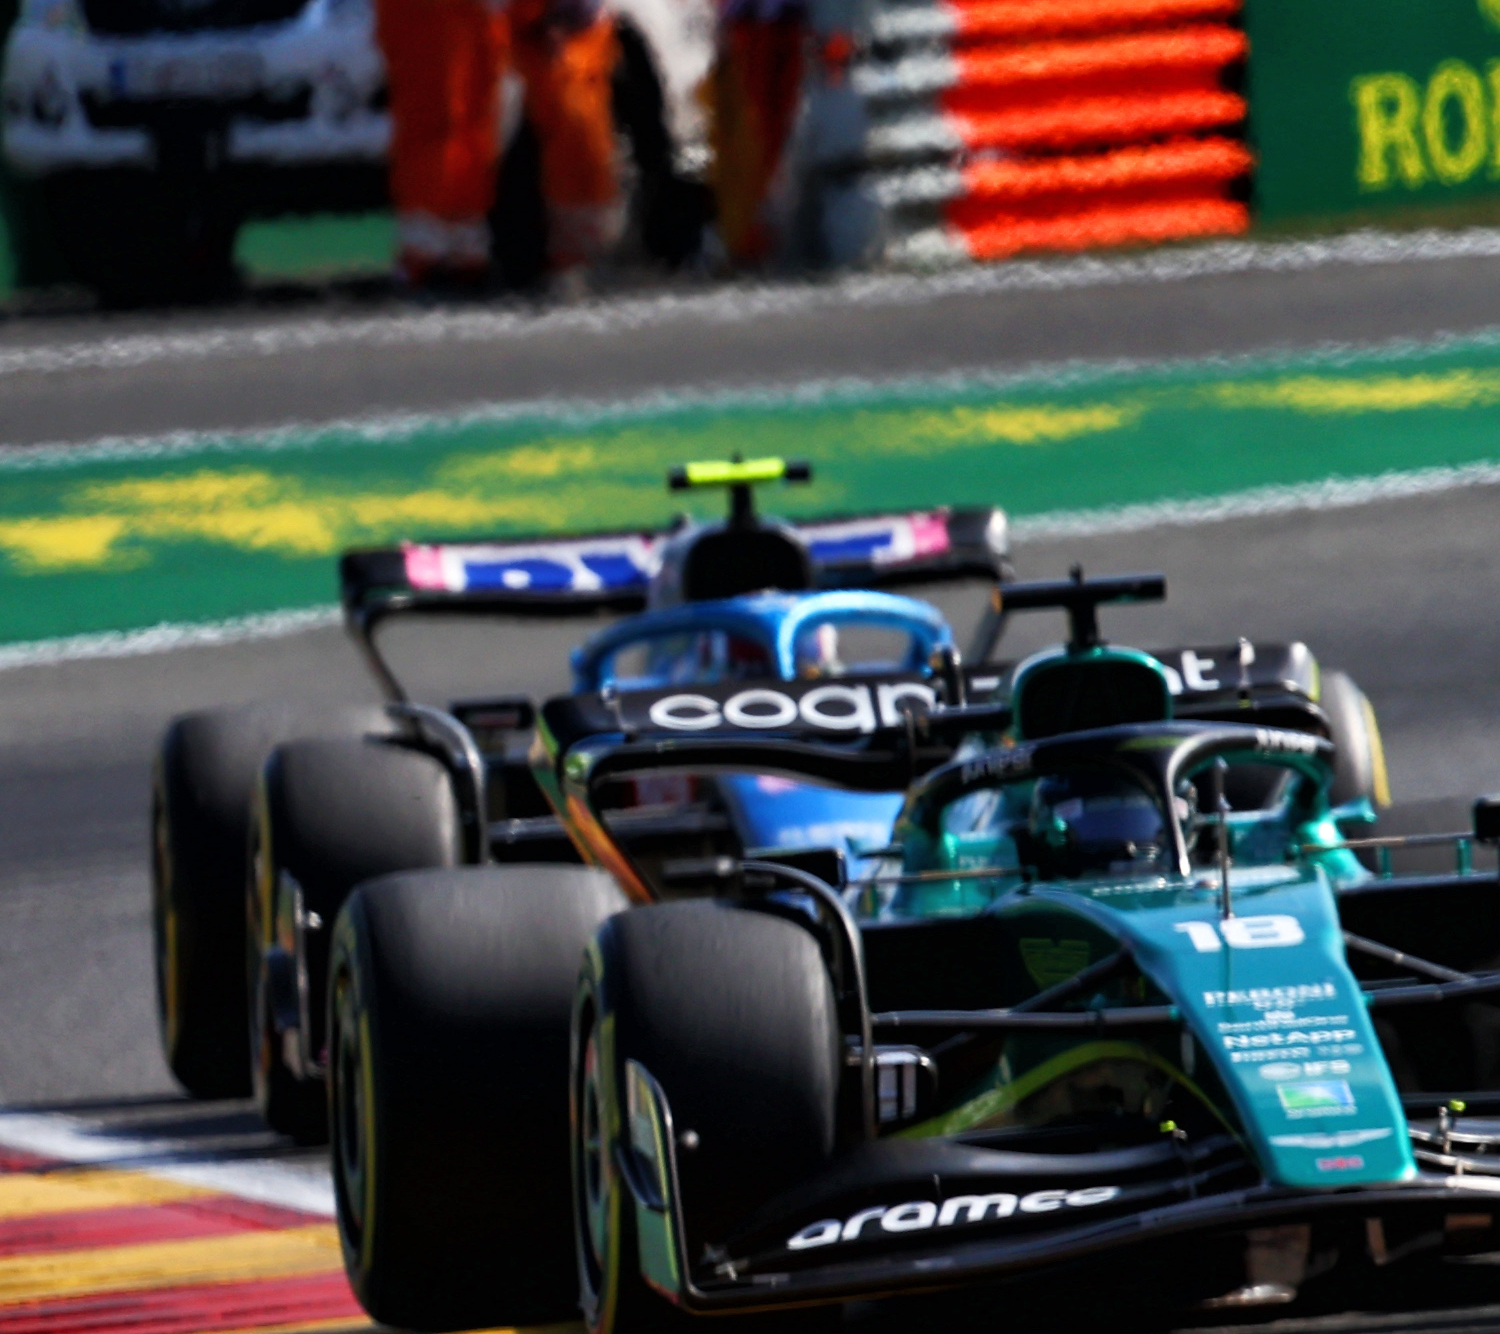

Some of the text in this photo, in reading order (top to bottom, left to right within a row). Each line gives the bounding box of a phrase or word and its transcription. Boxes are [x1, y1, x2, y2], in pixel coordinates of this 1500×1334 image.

[1174, 914, 1306, 953] 18
[1223, 1029, 1356, 1049] NetApp
[786, 1185, 1122, 1250] aramco
